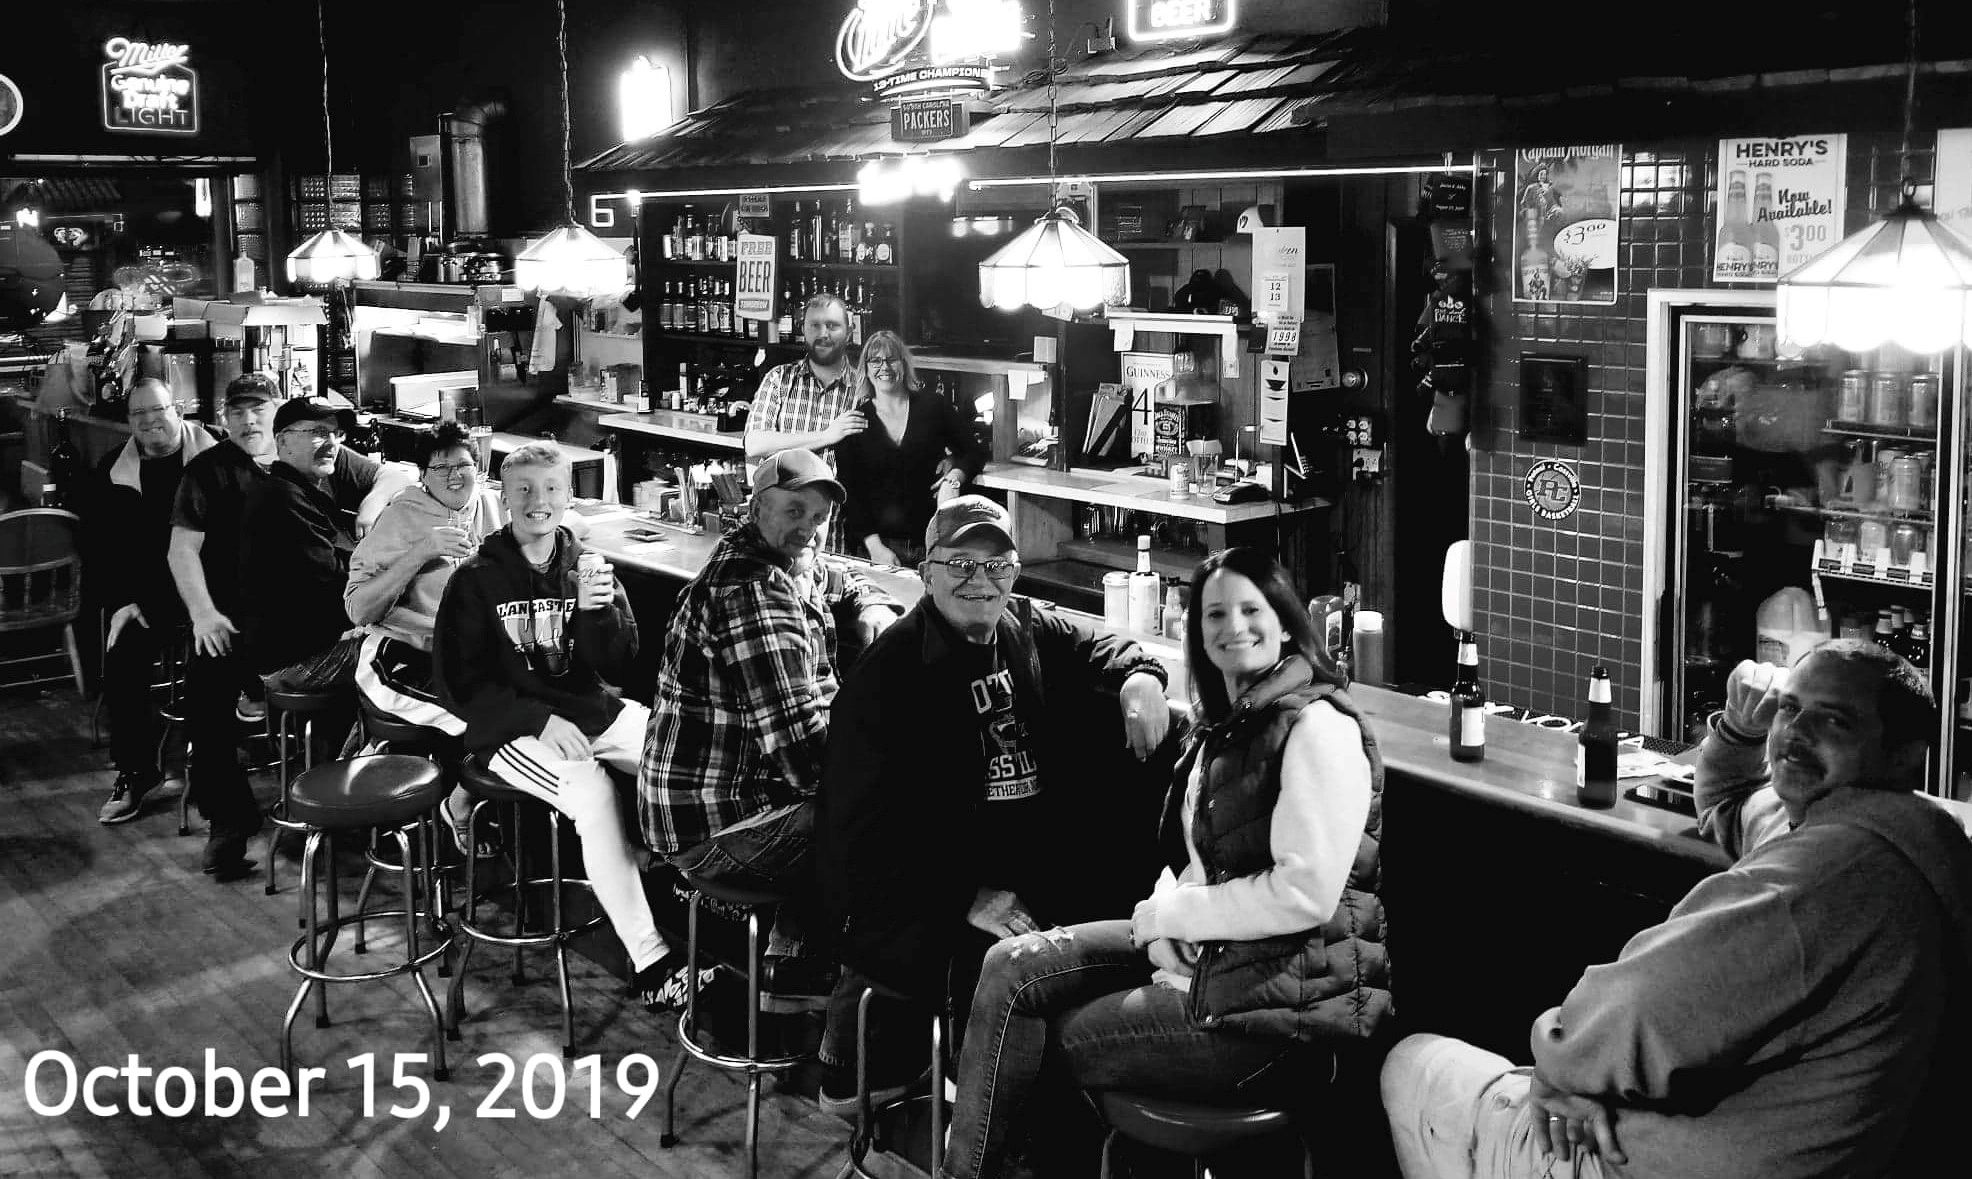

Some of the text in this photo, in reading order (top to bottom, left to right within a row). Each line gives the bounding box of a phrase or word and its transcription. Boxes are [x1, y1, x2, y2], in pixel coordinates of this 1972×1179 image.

[106, 37, 189, 68] Miller
[115, 107, 188, 124] LIGHT
[904, 110, 950, 130] PACKERS
[1736, 140, 1828, 158] HENRY'S
[1749, 158, 1814, 168] HARD SODA
[1778, 188, 1811, 204] New
[1757, 199, 1832, 222] Available!
[741, 241, 773, 255] FREE
[739, 261, 771, 292] BEER
[1270, 282, 1281, 291] 12
[1272, 331, 1297, 342] 1998
[1126, 366, 1171, 380] GUINNESS
[499, 600, 575, 615] LANCASTE
